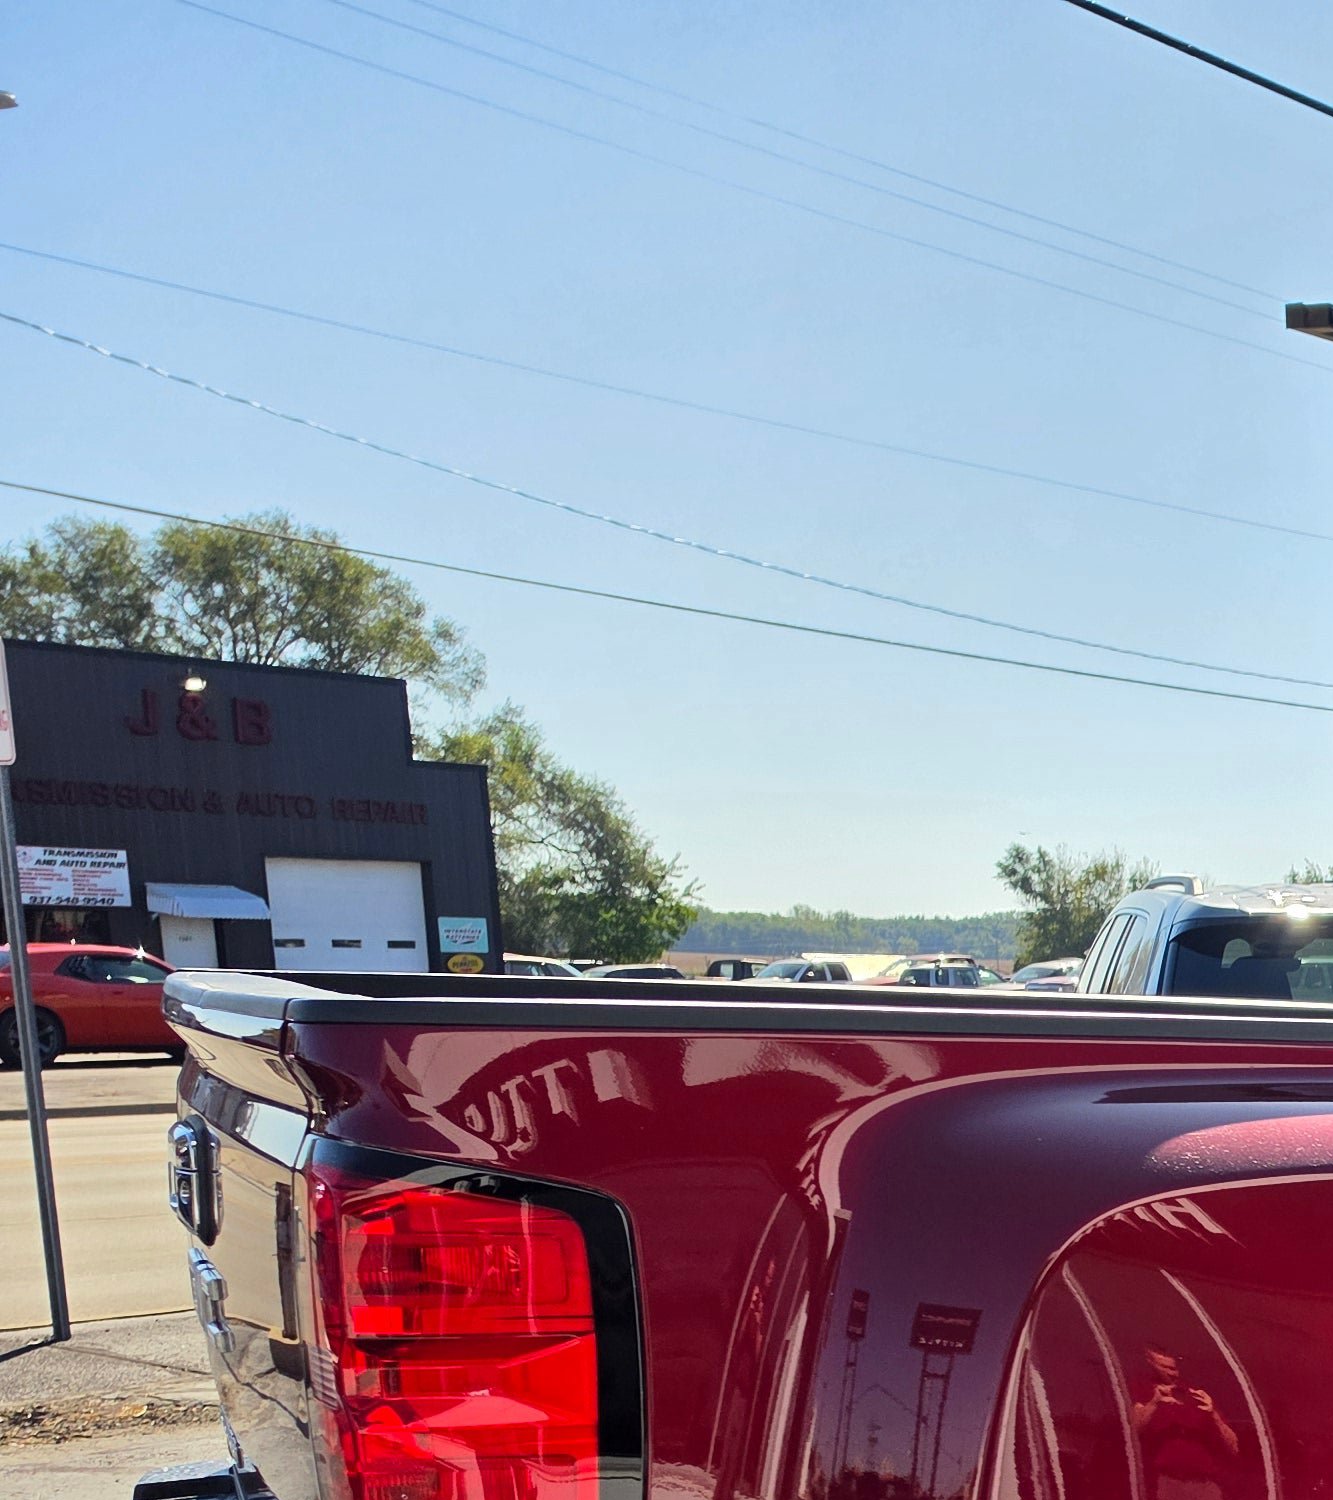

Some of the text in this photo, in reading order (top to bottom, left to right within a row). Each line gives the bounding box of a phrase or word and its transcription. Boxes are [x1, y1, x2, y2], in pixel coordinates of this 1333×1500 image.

[123, 688, 273, 745] J & B
[236, 791, 316, 819] AUTO
[332, 797, 428, 825] REPAIR
[35, 859, 126, 869] AND AUTO REPAIR
[43, 849, 118, 859] TRANSMISSION
